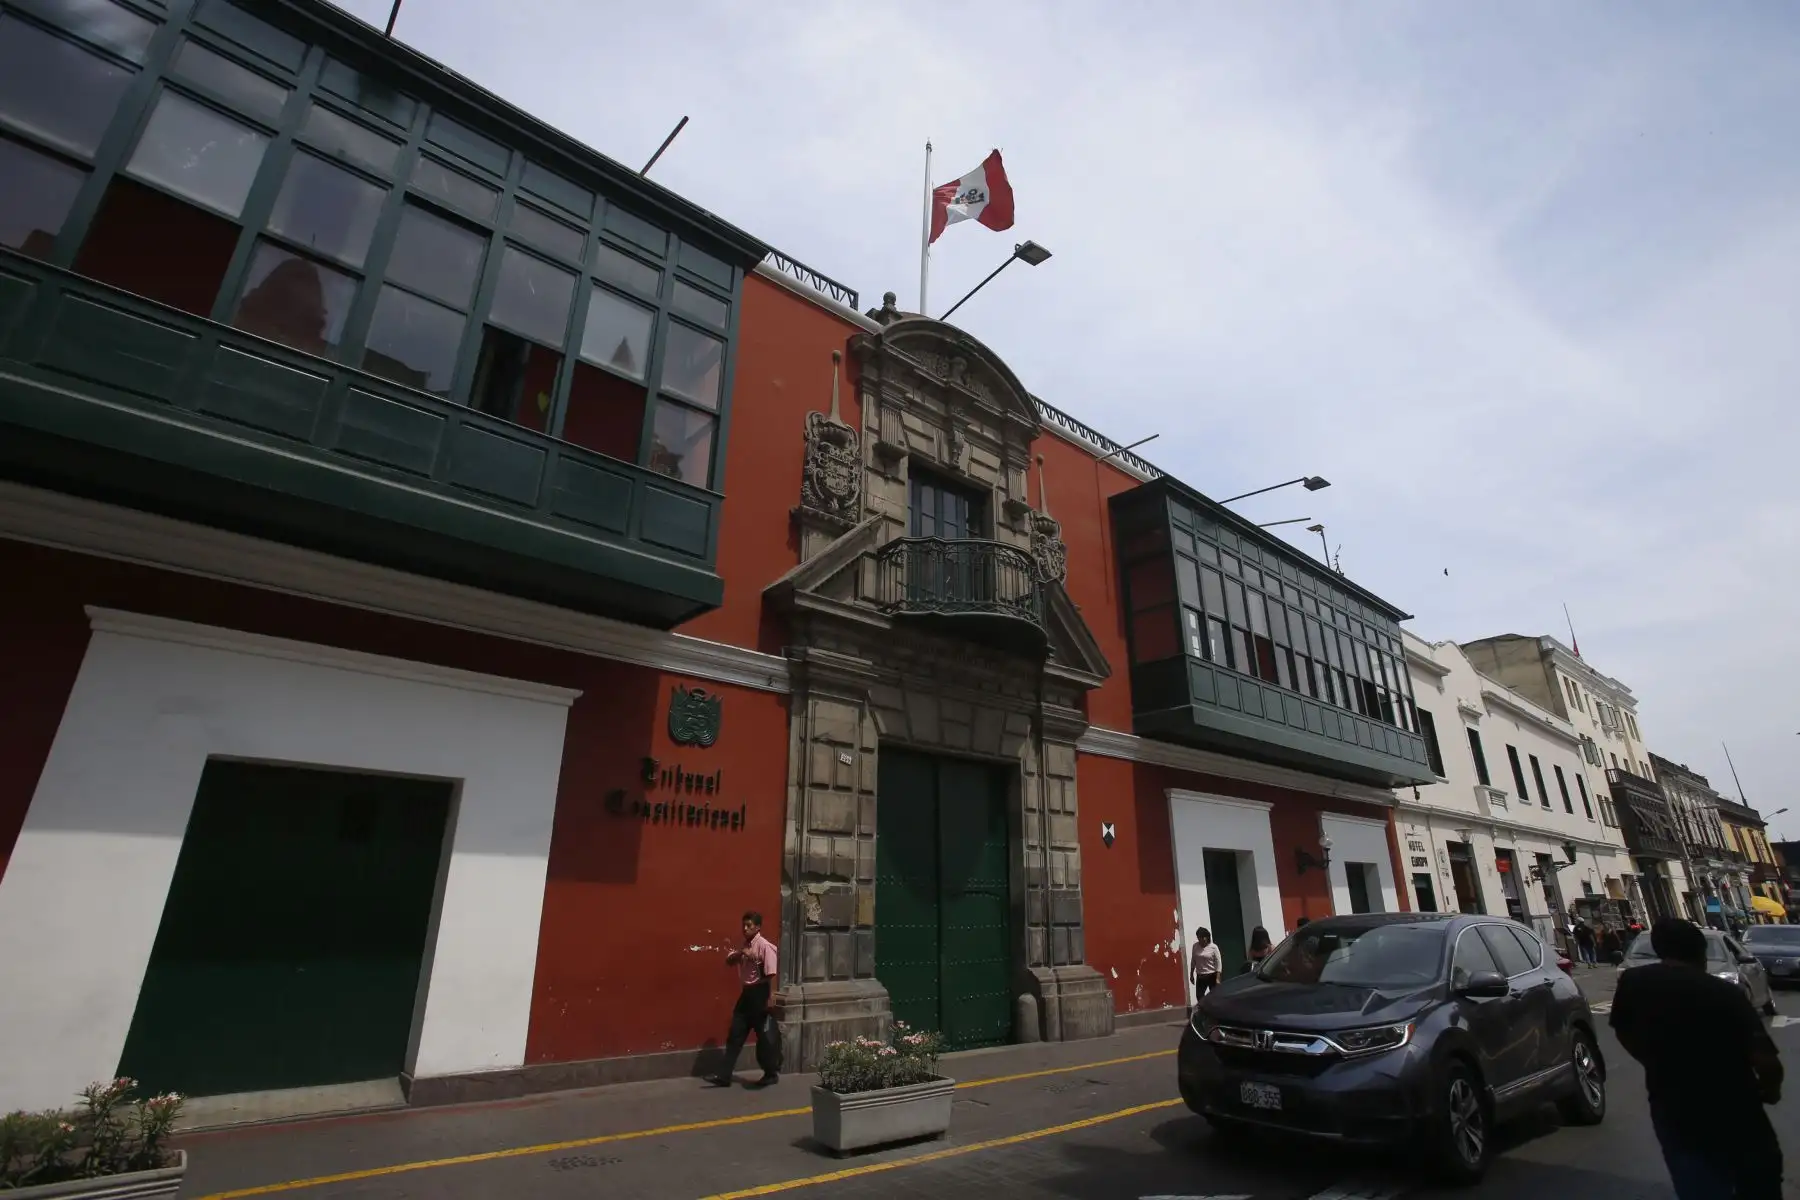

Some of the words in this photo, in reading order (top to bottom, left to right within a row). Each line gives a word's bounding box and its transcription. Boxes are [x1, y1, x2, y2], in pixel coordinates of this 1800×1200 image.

[641, 756, 722, 795] Tribunal
[604, 788, 748, 832] Constitucional
[1408, 840, 1426, 852] HOTEL
